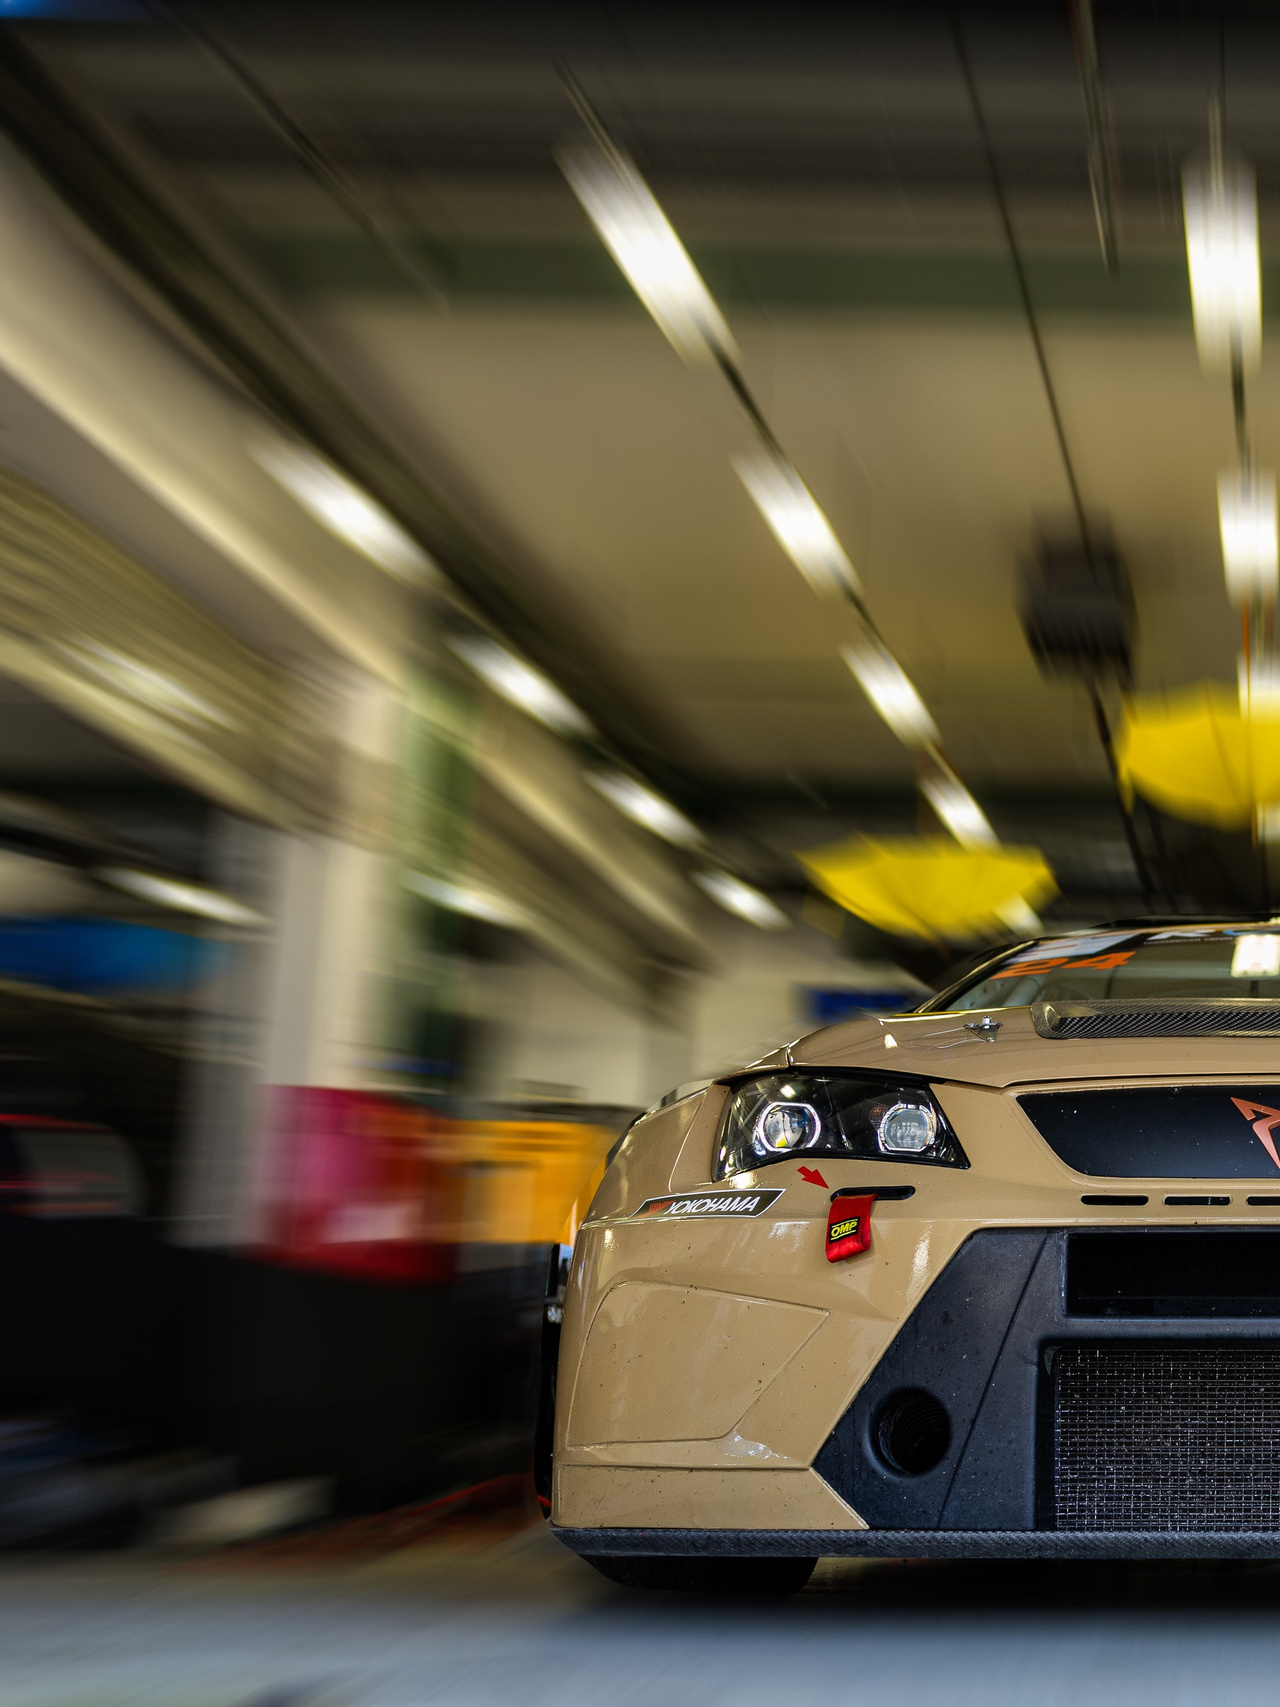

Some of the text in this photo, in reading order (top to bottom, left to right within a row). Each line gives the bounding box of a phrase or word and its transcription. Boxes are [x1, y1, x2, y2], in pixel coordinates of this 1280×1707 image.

[990, 951, 1137, 980] 24
[663, 1196, 761, 1216] YOKOHAMA
[830, 1221, 858, 1238] OMP
